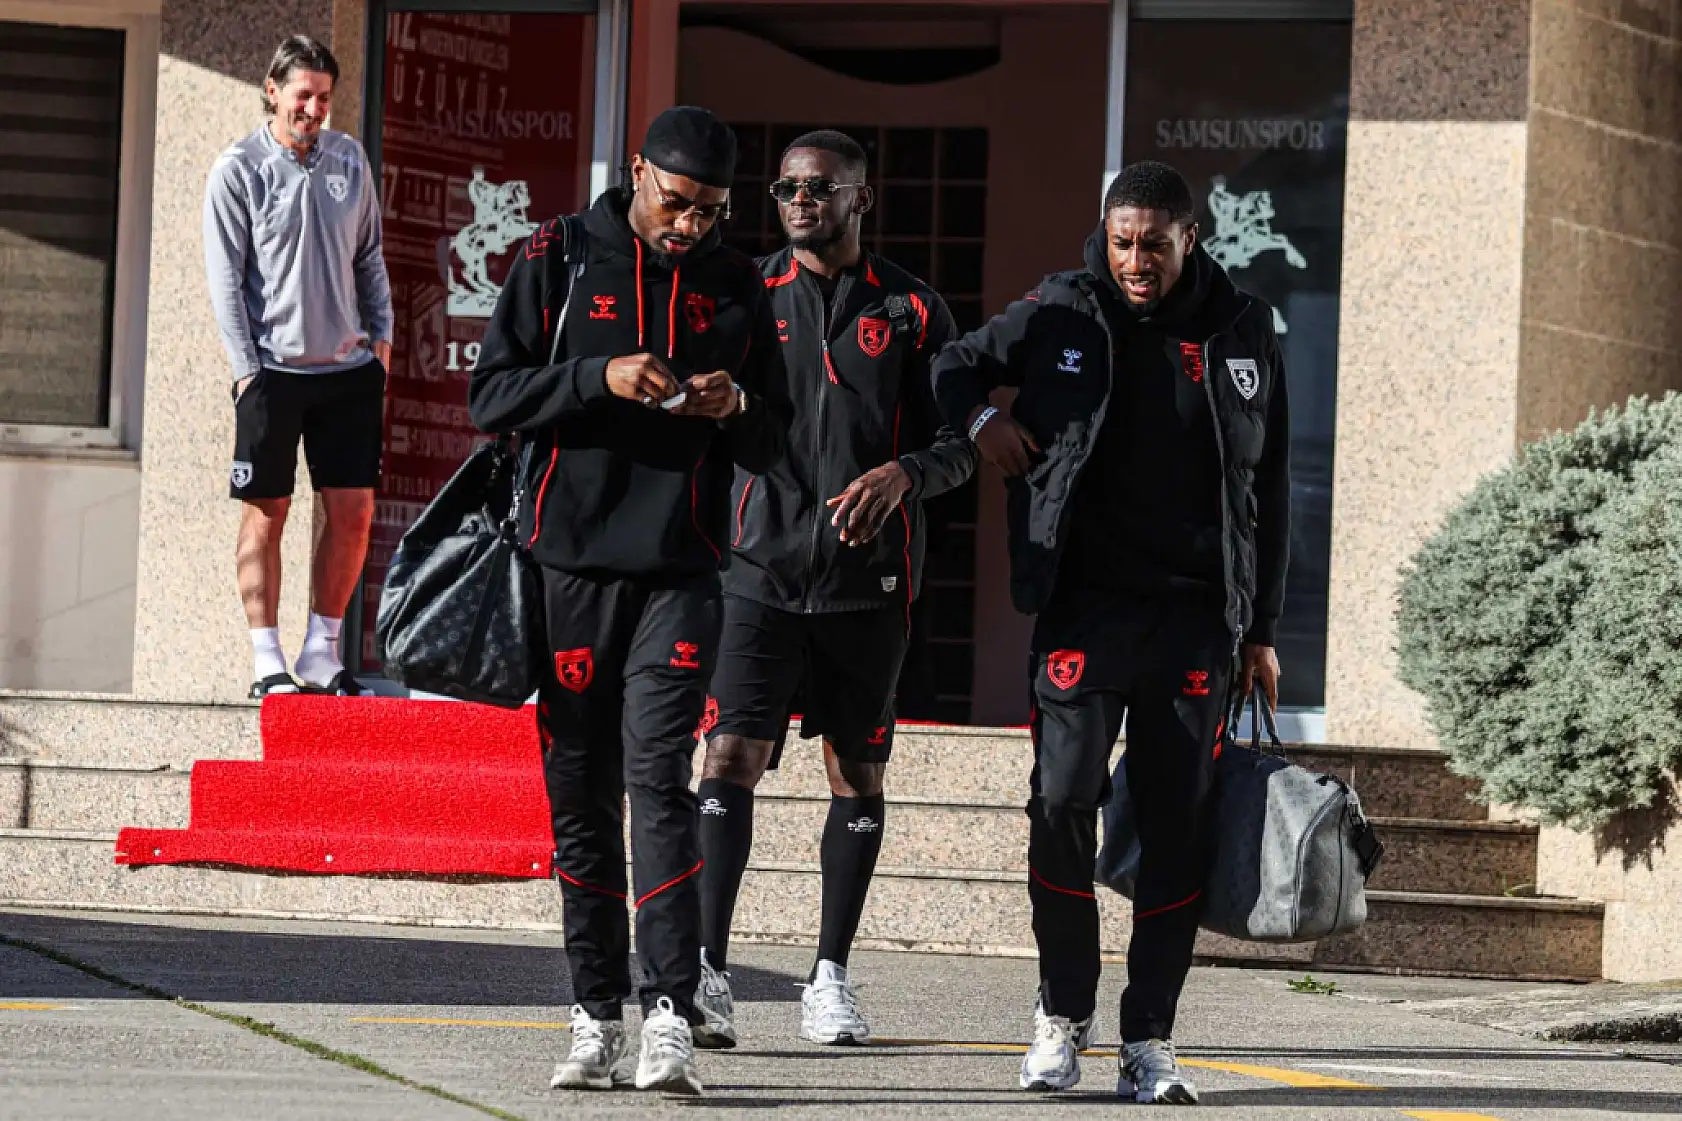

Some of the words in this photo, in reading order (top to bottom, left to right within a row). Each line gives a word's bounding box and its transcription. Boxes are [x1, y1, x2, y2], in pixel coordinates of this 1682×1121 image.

[418, 109, 573, 141] MSUNSPOR
[1156, 119, 1325, 149] SAMSUNSPOR
[445, 341, 482, 371] 19
